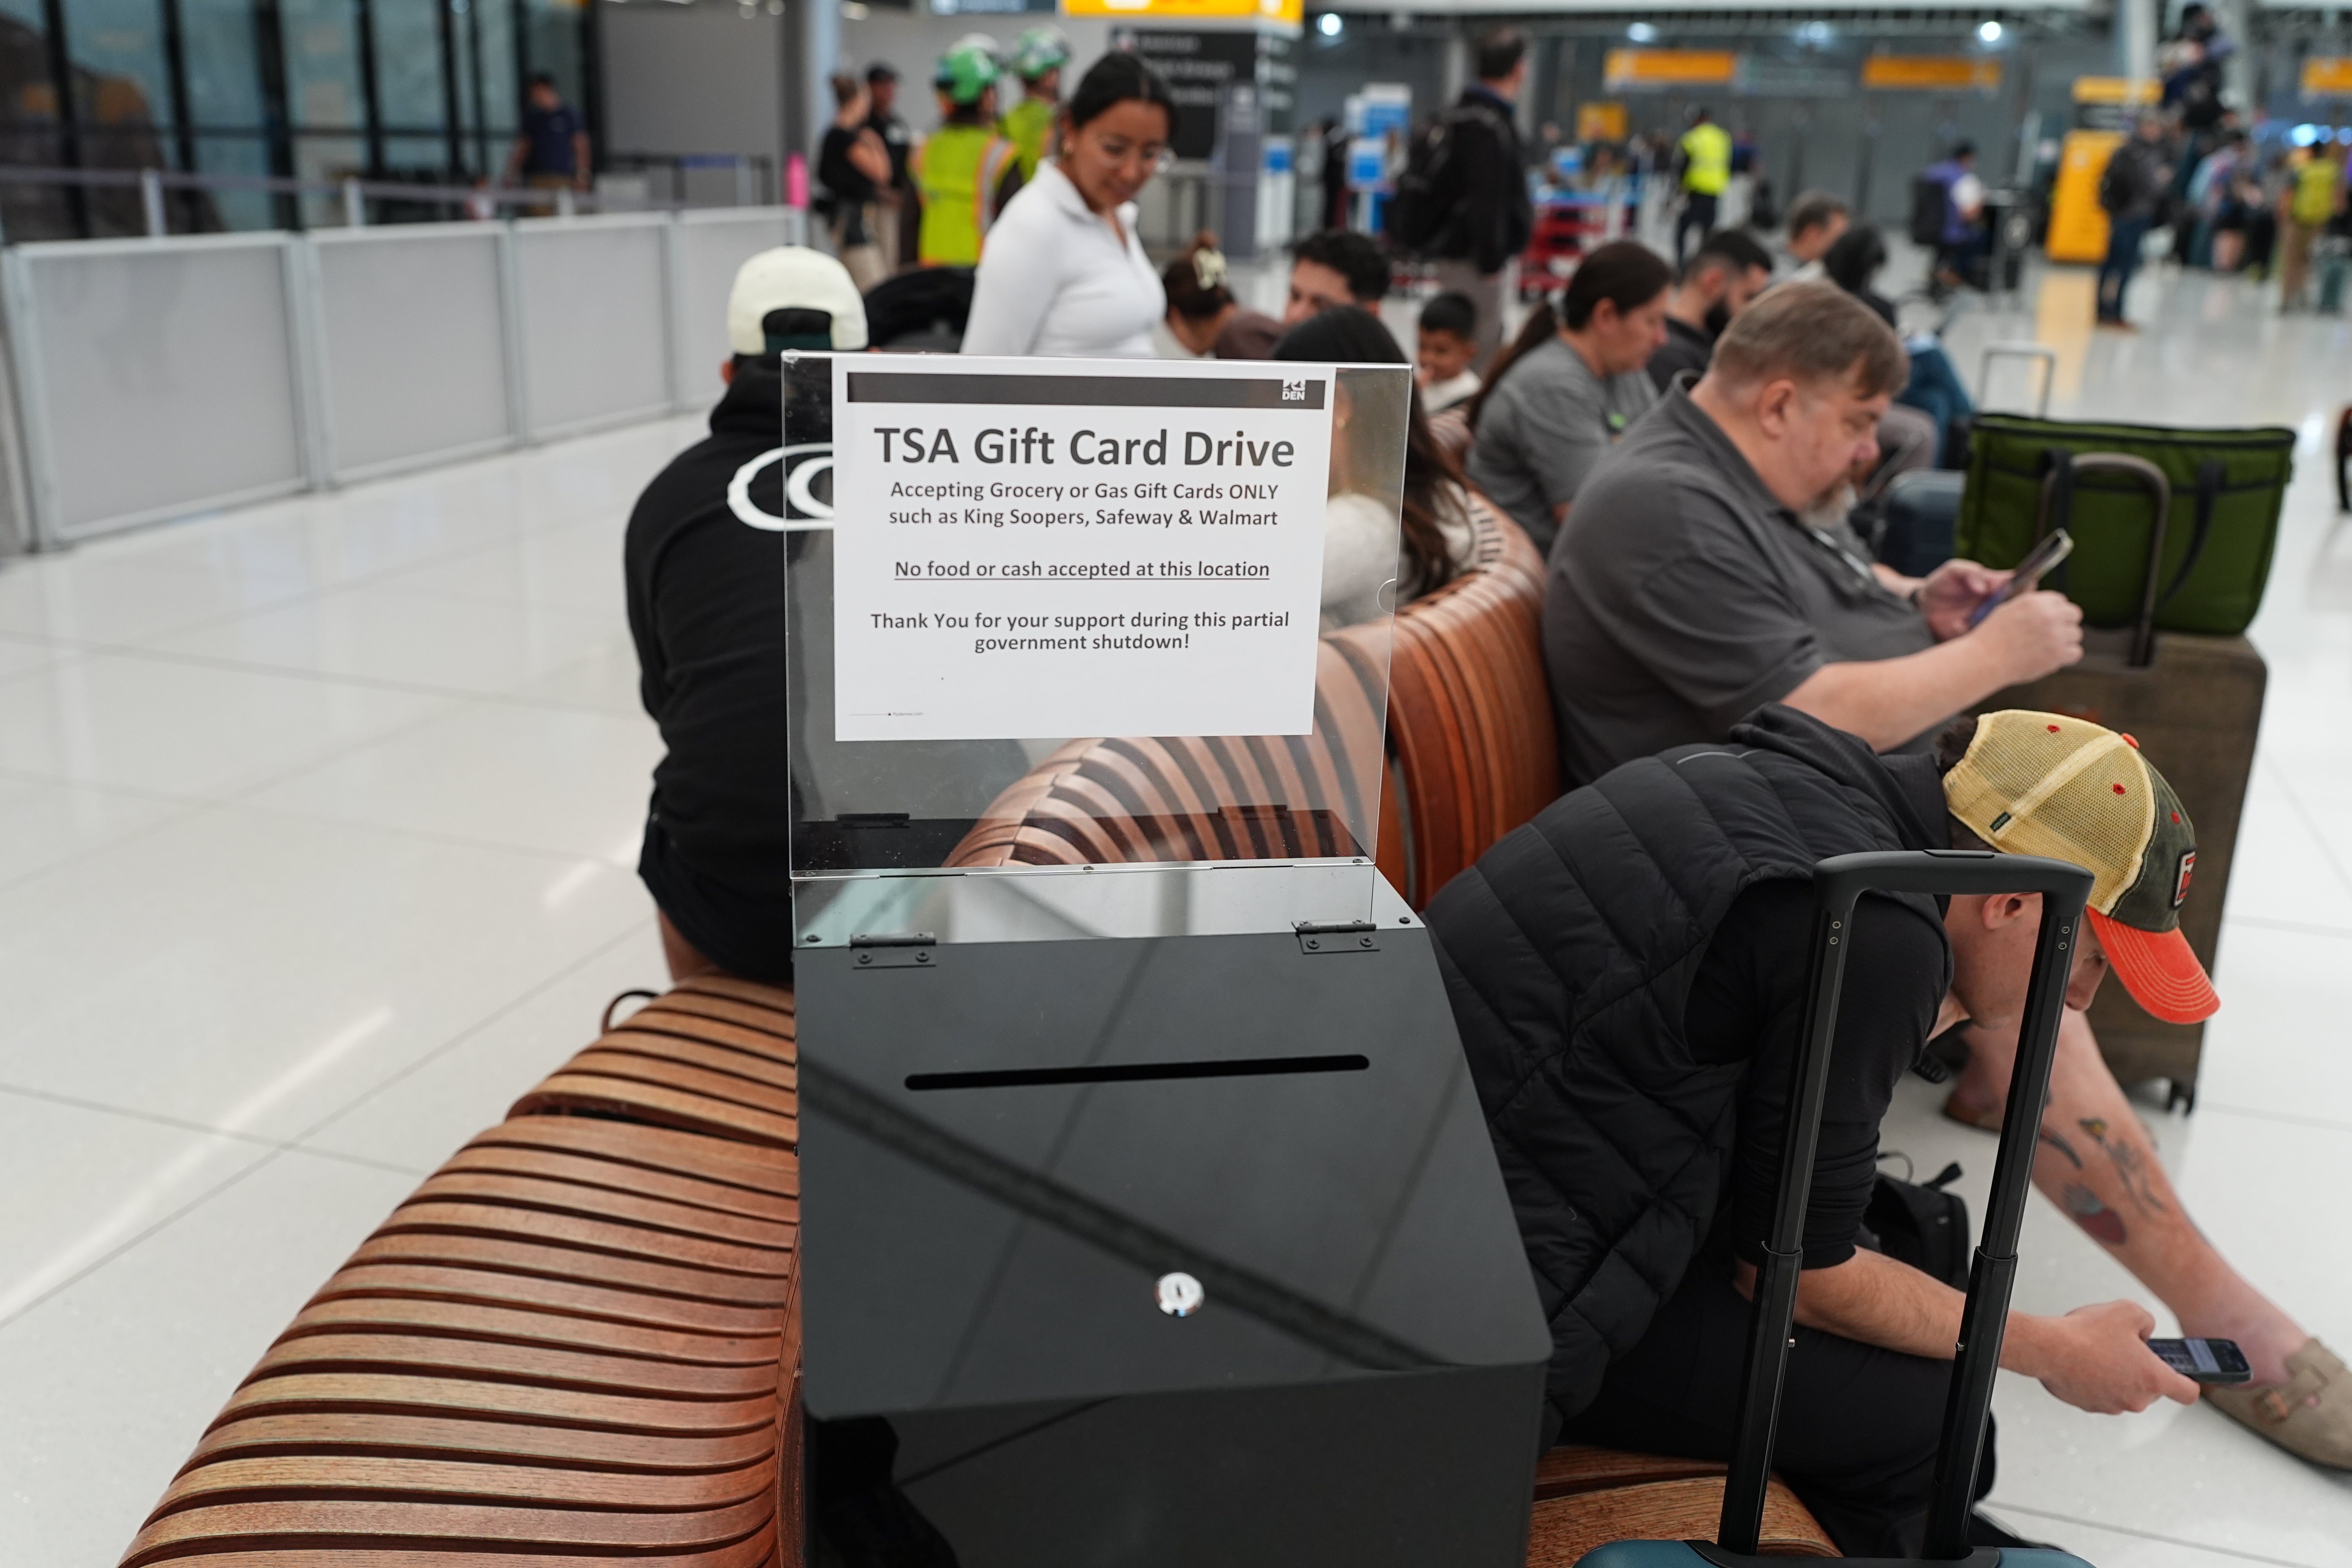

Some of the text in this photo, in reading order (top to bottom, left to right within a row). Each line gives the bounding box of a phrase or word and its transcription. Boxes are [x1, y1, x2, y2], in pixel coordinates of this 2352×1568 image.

[1281, 390, 1306, 401] DEN
[874, 426, 1294, 467] TSA Gift Card Drive
[891, 481, 1278, 502] Accepting Grocery or Gas Gift Cards ONLY
[889, 508, 1278, 528] such as King Soopers, Safeway & Walmart
[895, 561, 1269, 580] No food or cash accepted at this location
[870, 611, 1289, 632] Thank You for your support during this partial
[975, 633, 1189, 654] government shutdown!
